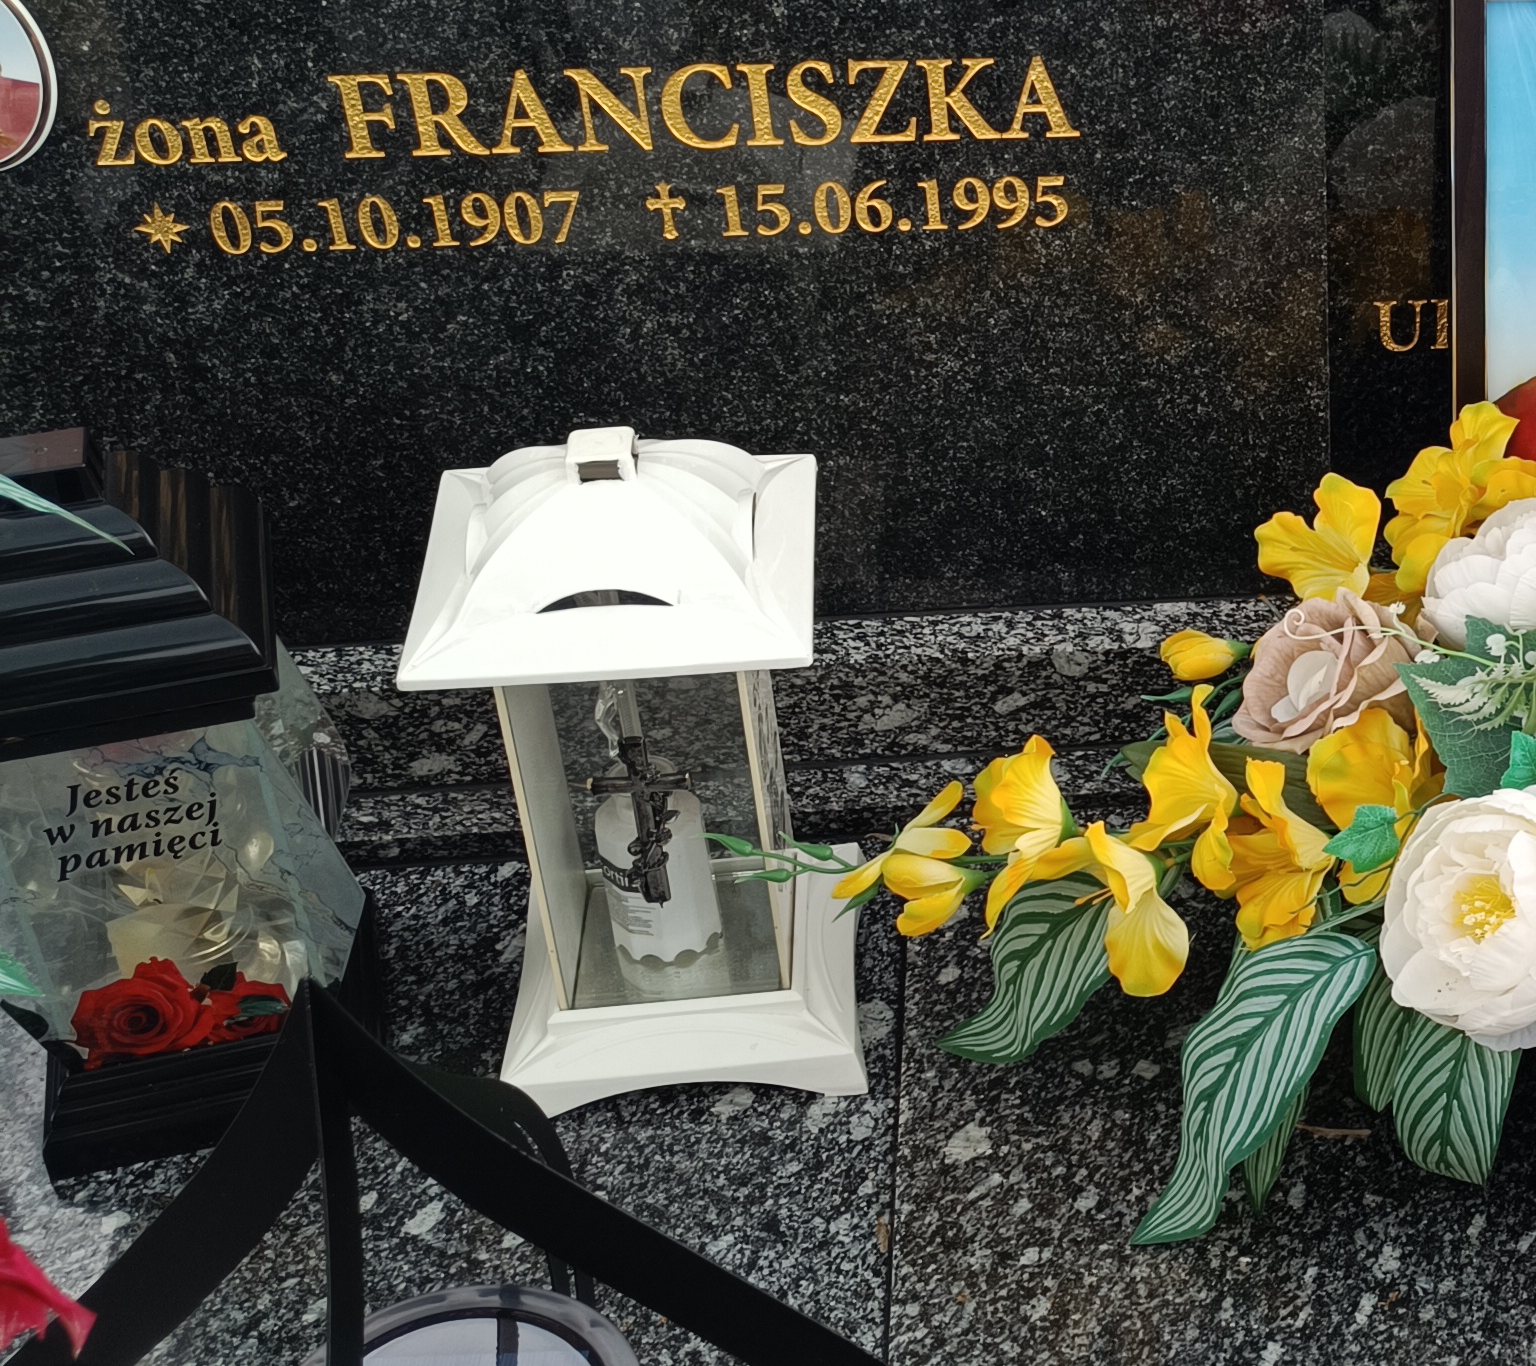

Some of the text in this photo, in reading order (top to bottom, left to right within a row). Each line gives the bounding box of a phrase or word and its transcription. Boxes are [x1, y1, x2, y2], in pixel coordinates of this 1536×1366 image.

[87, 55, 1081, 167] żona FRANCISZKA
[210, 174, 1070, 255] 05.10.1907 15.06.1995
[43, 791, 218, 846] w naszej
[65, 766, 180, 818] Jesteś
[56, 821, 223, 883] pamięci
